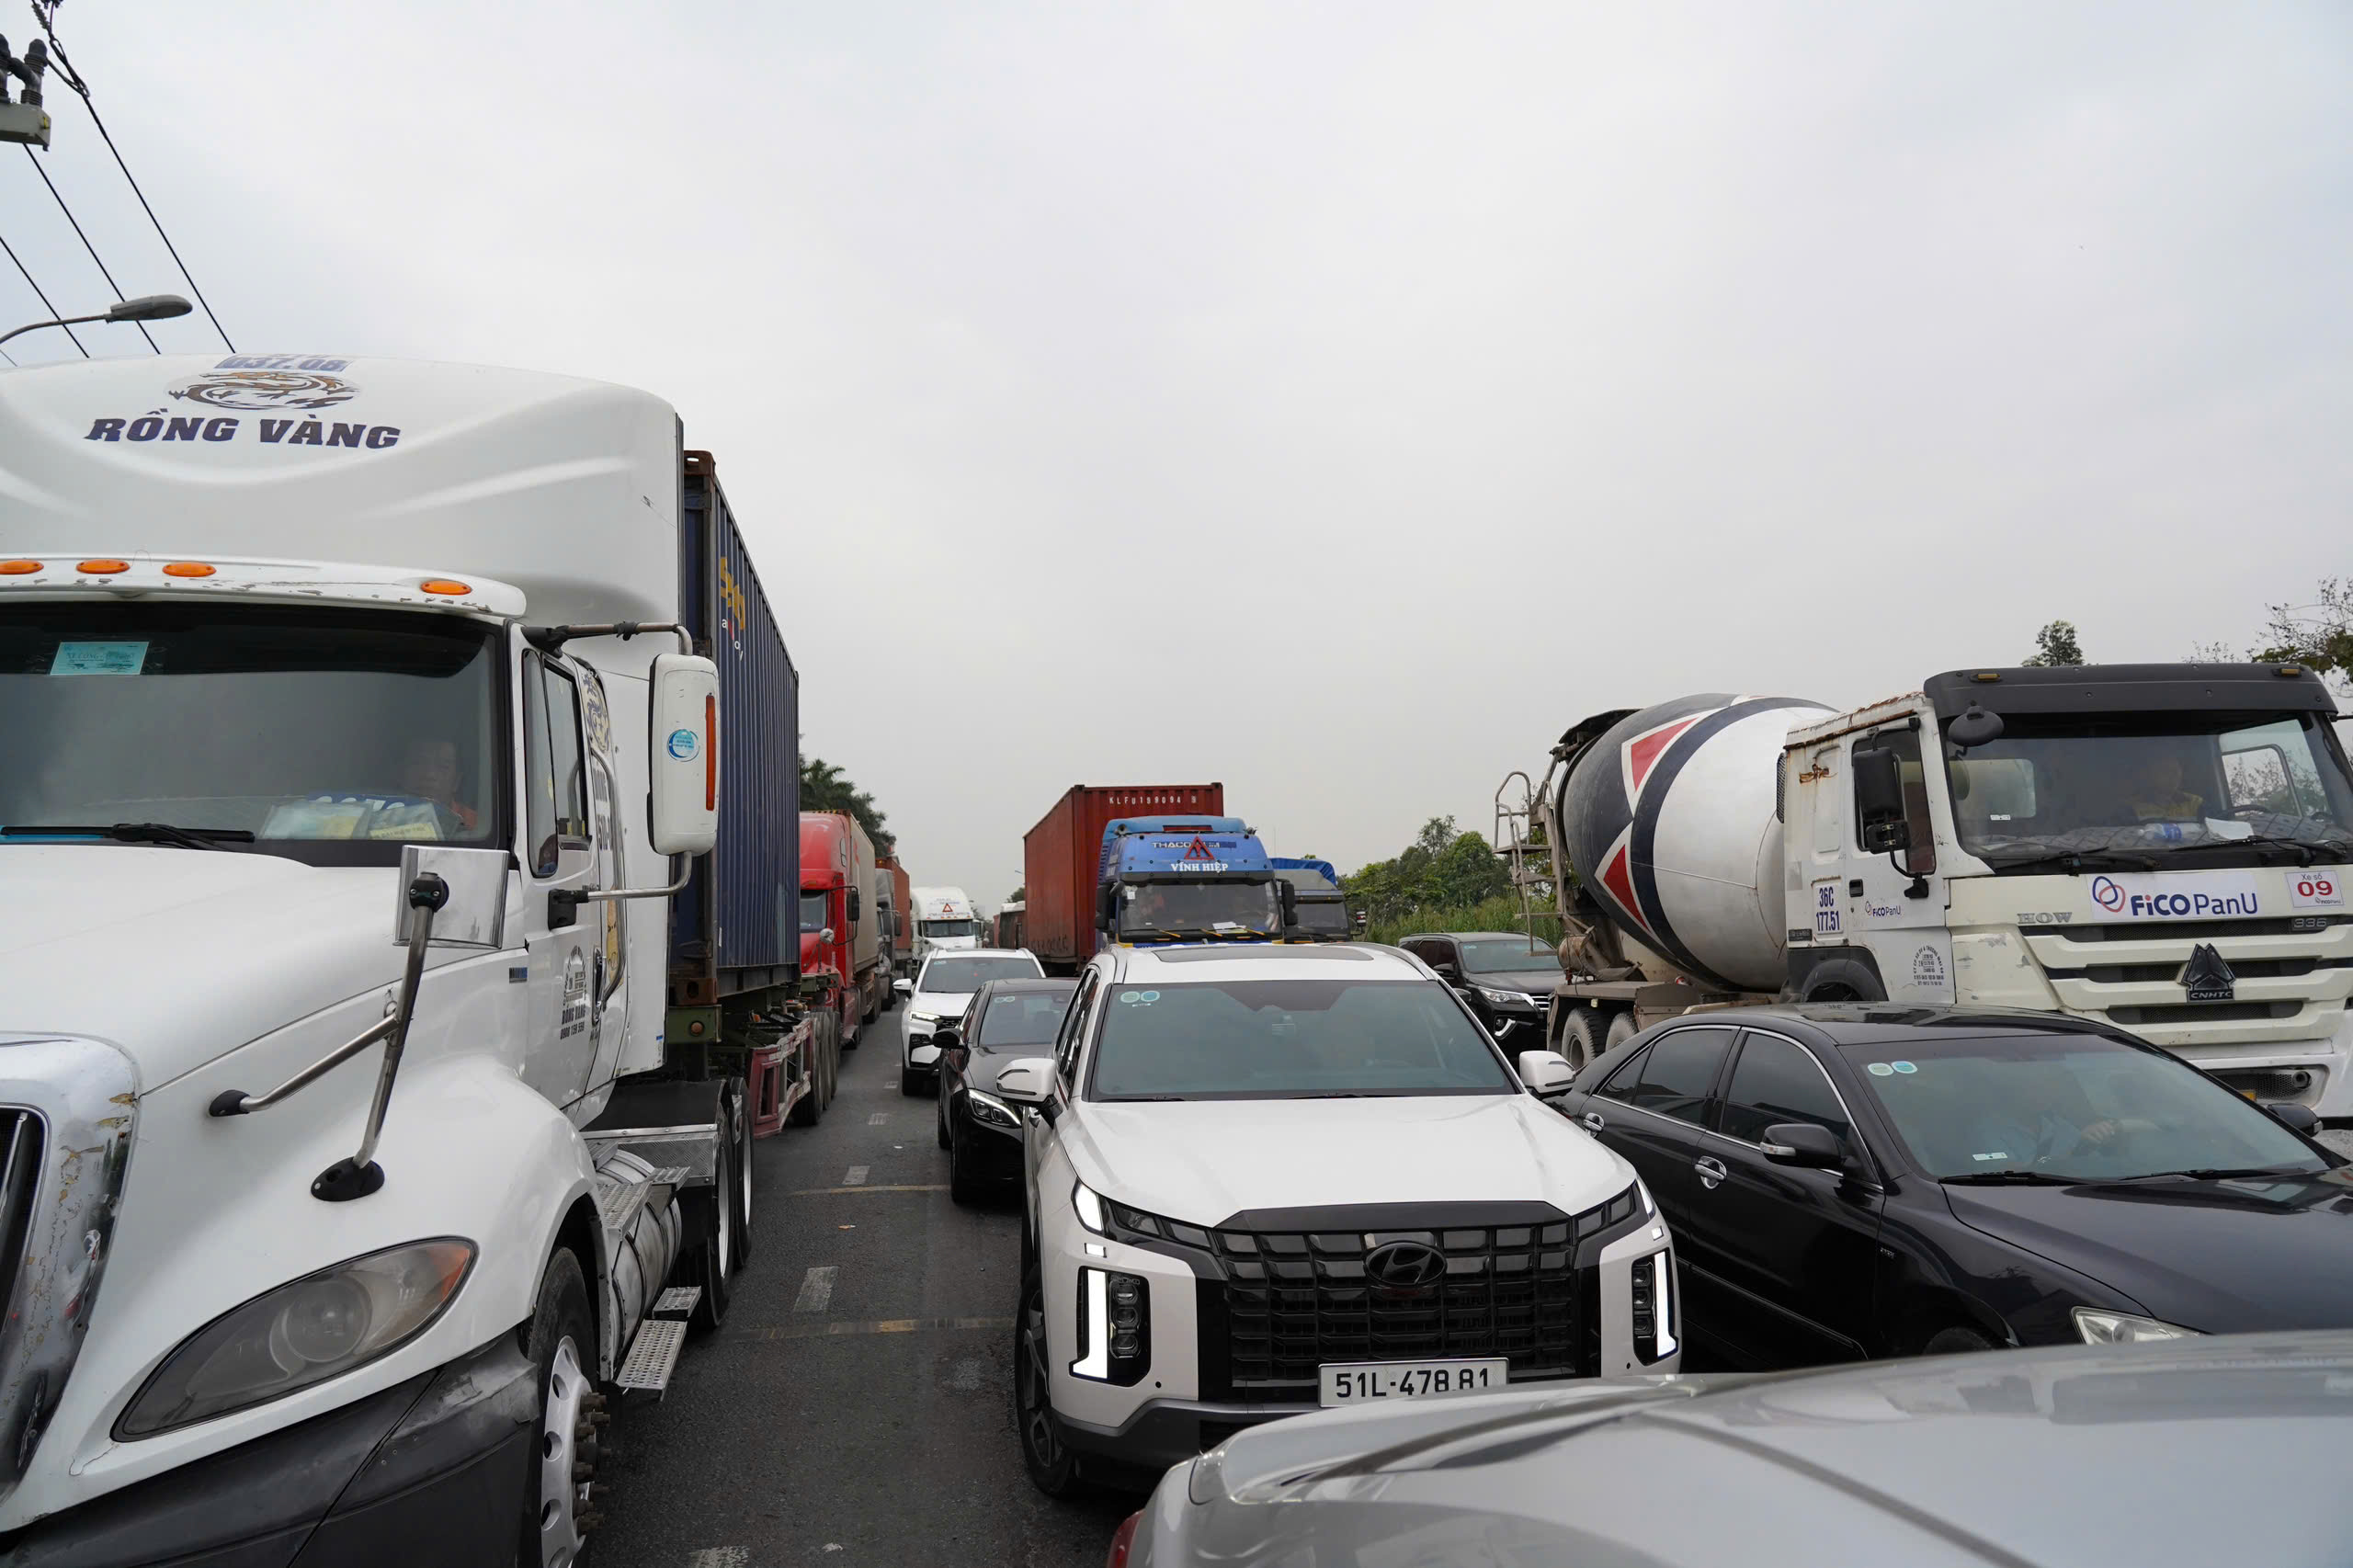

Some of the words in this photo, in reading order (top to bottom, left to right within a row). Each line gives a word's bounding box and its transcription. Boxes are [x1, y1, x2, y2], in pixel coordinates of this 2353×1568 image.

[83, 408, 240, 442] RỒNG
[259, 414, 402, 449] VÀNG
[1202, 861, 1229, 873] HIỆP
[1819, 886, 1834, 907] 36C
[2298, 881, 2333, 897] 09
[1816, 911, 1840, 931] 177.51
[2017, 912, 2073, 924] HOW
[2293, 918, 2326, 927] 336
[1336, 1368, 1489, 1398] 51L-478.81
